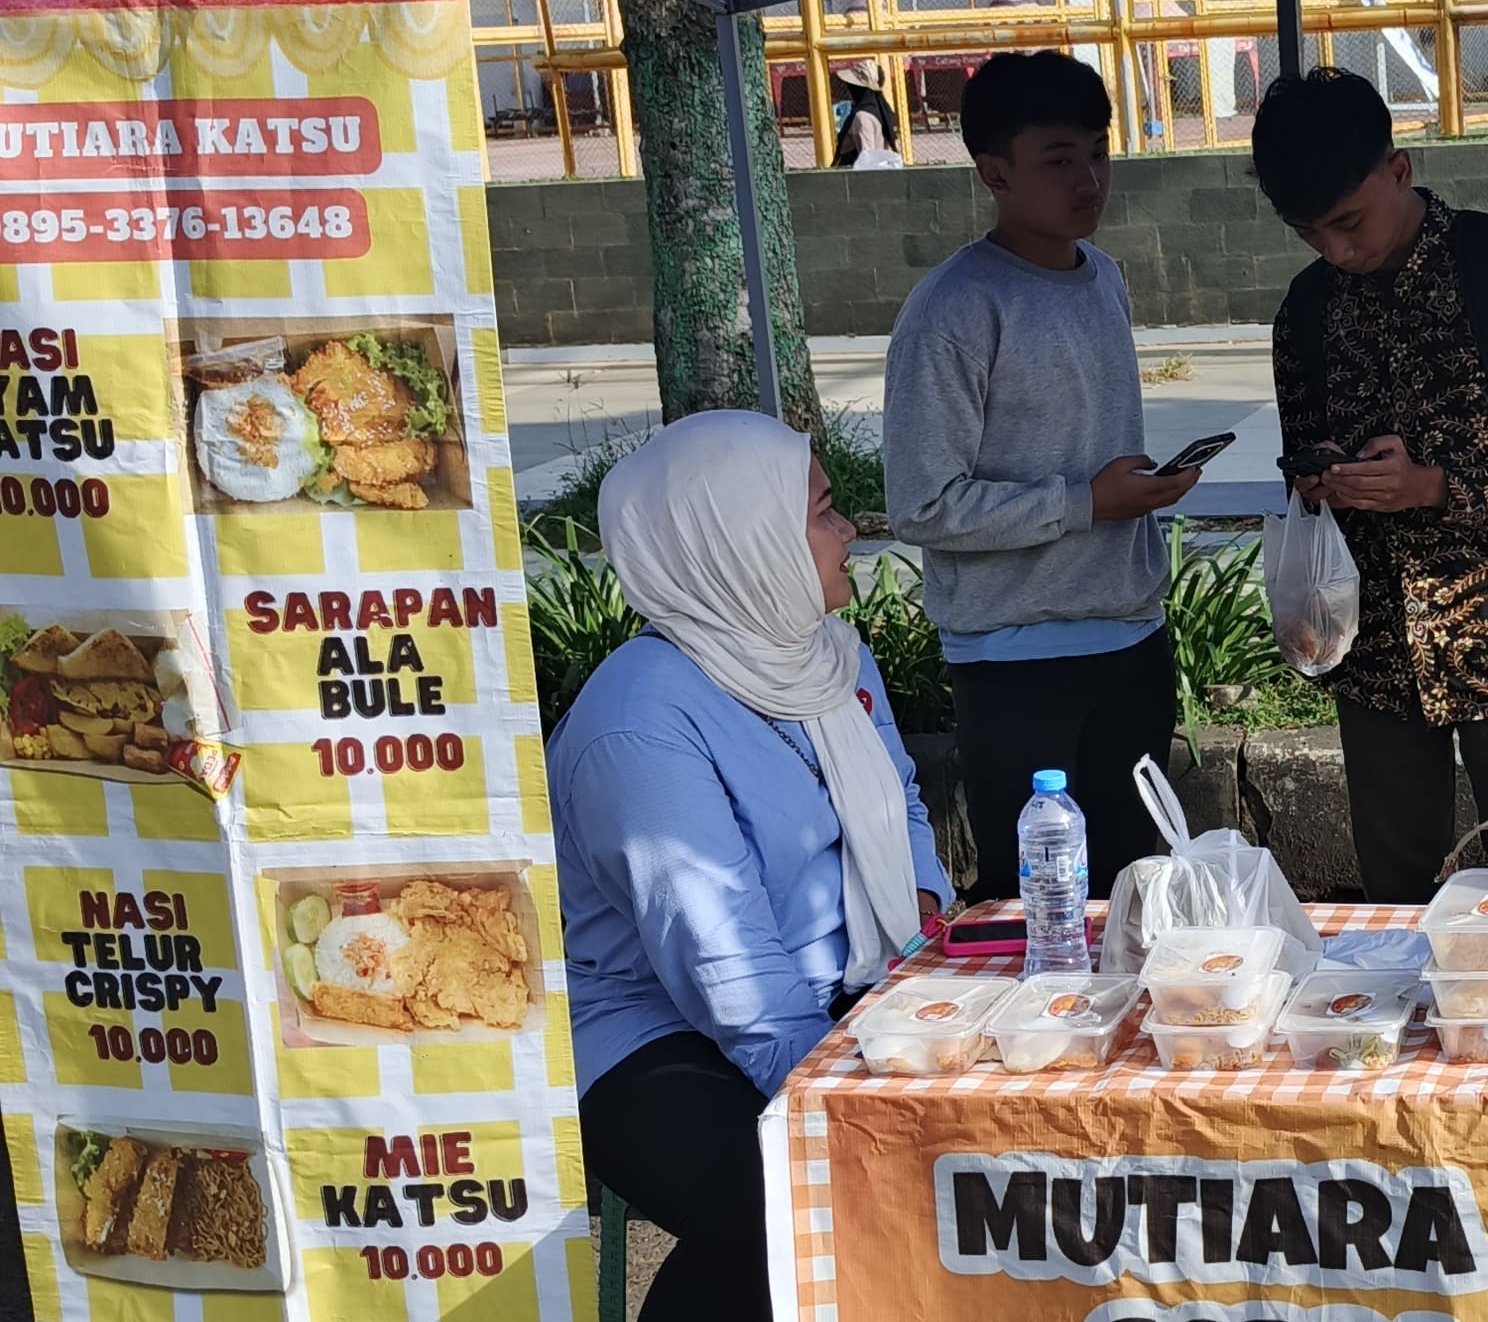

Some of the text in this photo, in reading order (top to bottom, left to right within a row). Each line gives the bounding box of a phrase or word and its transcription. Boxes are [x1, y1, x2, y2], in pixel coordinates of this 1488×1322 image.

[195, 116, 361, 155] KATSU
[0, 206, 353, 244] 895-3376-13648
[0, 476, 110, 518] 0.000
[244, 587, 498, 633] SARAPAN
[317, 634, 424, 676] ALA
[319, 675, 446, 720] BULE
[311, 733, 464, 777] 10.000
[80, 890, 188, 930] NASI
[61, 931, 201, 972] TELUR
[64, 970, 222, 1013] CRISPY
[87, 1024, 219, 1065] 10.000
[363, 1131, 474, 1178] MIE
[320, 1178, 528, 1228] KATSU
[951, 1170, 1476, 1278] MUTIARA
[360, 1242, 503, 1280] 10.000
